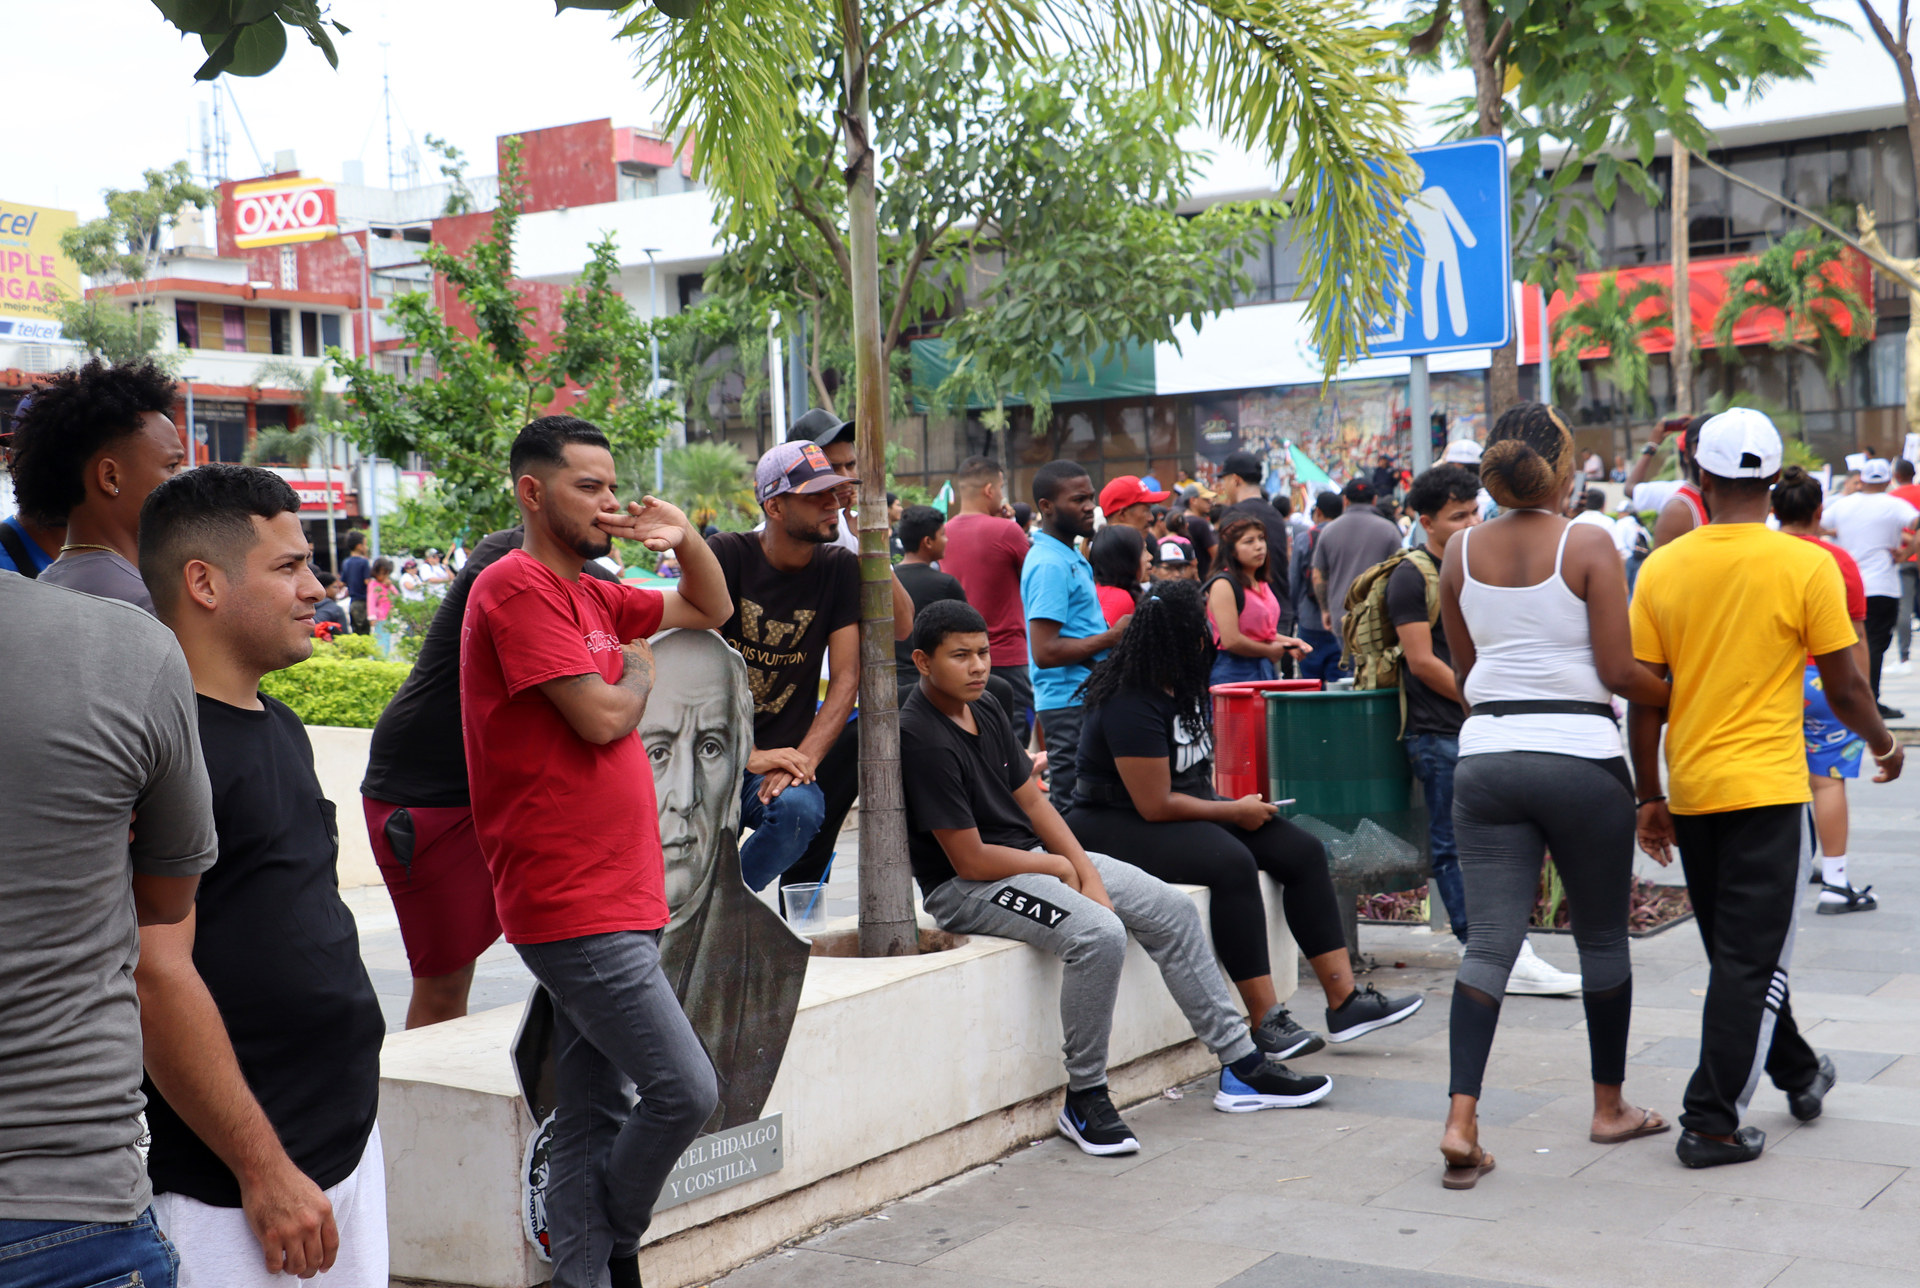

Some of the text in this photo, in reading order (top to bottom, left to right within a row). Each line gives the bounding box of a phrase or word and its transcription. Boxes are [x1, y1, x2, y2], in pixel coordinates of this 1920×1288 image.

[0, 207, 38, 236] cel
[237, 190, 324, 234] OXXO
[4, 302, 31, 312] mejor
[18, 322, 57, 339] telcel
[296, 489, 342, 503] ORTE
[726, 638, 808, 667] OUIS VUITTON
[710, 1124, 777, 1160] HIDALGO
[670, 1156, 758, 1199] Y COSTILLA
